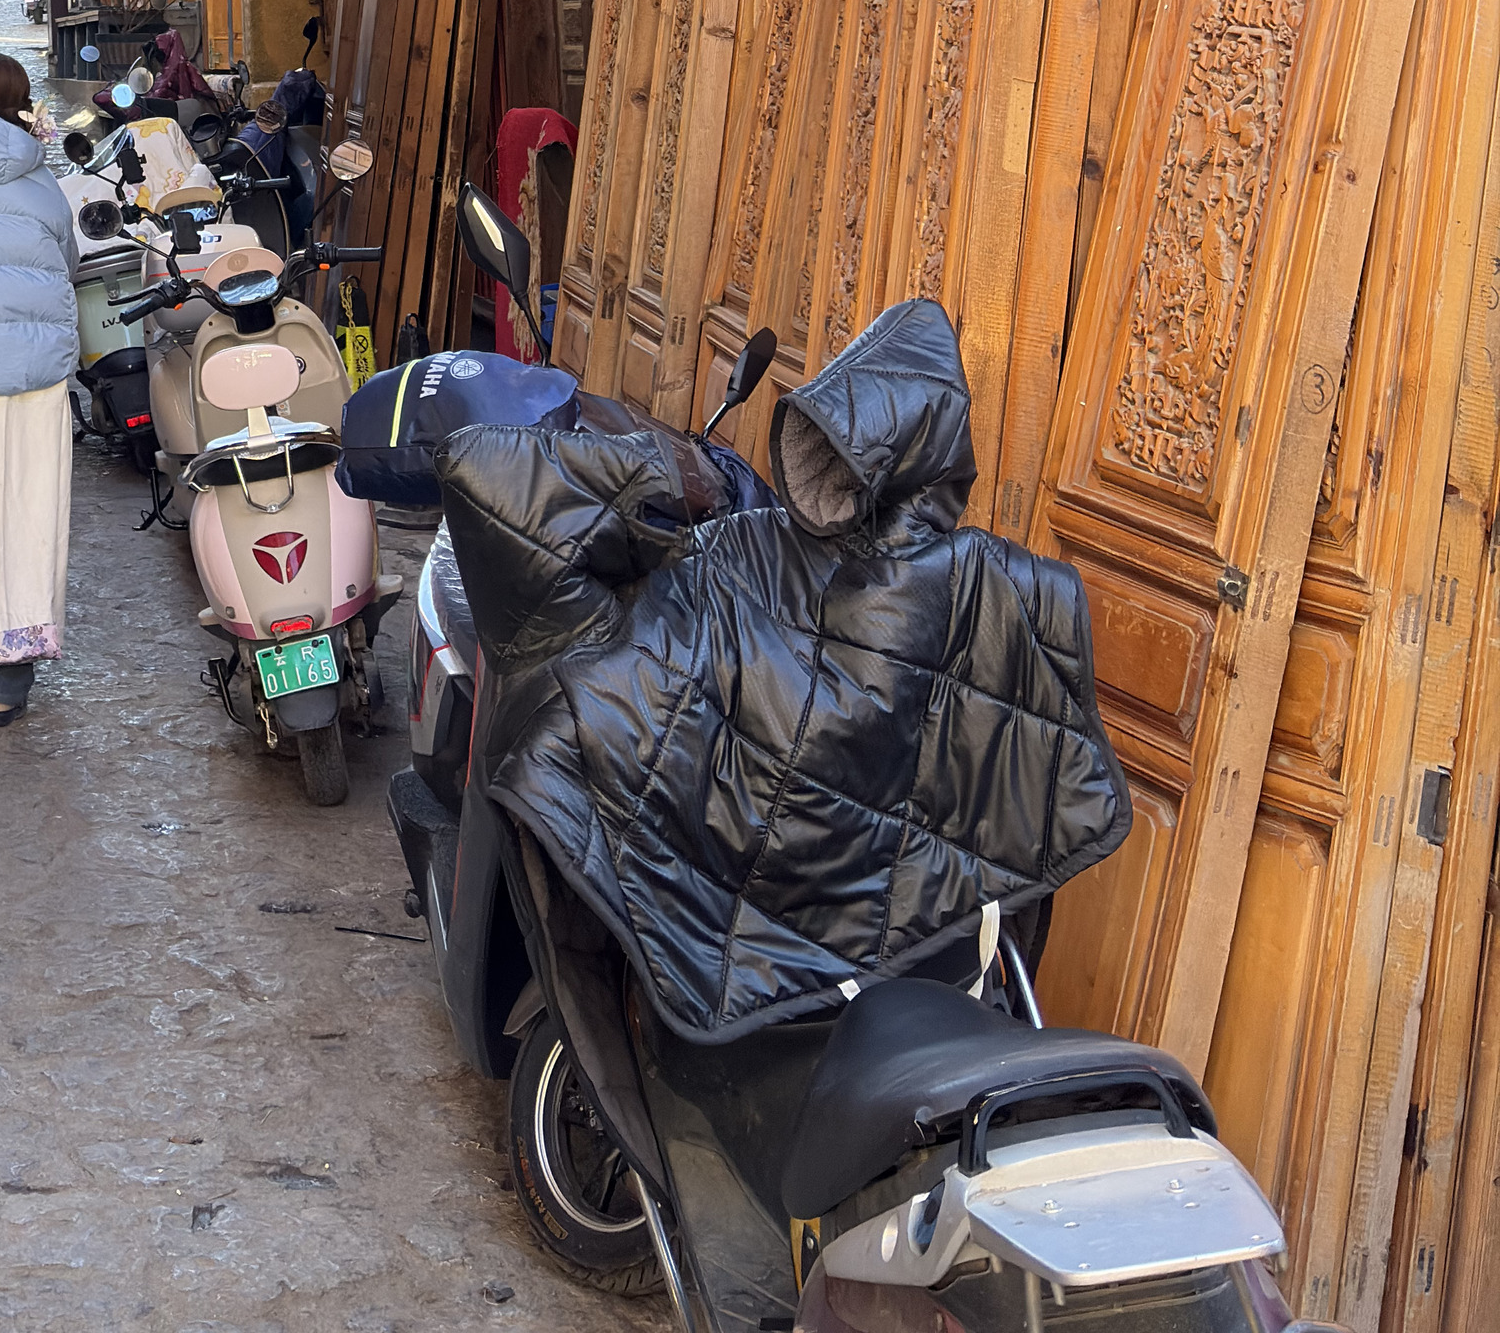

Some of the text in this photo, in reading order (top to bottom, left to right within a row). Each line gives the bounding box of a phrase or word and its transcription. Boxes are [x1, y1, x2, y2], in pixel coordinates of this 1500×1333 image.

[419, 351, 461, 399] MAHA
[300, 645, 315, 661] R
[266, 659, 333, 693] 01165
